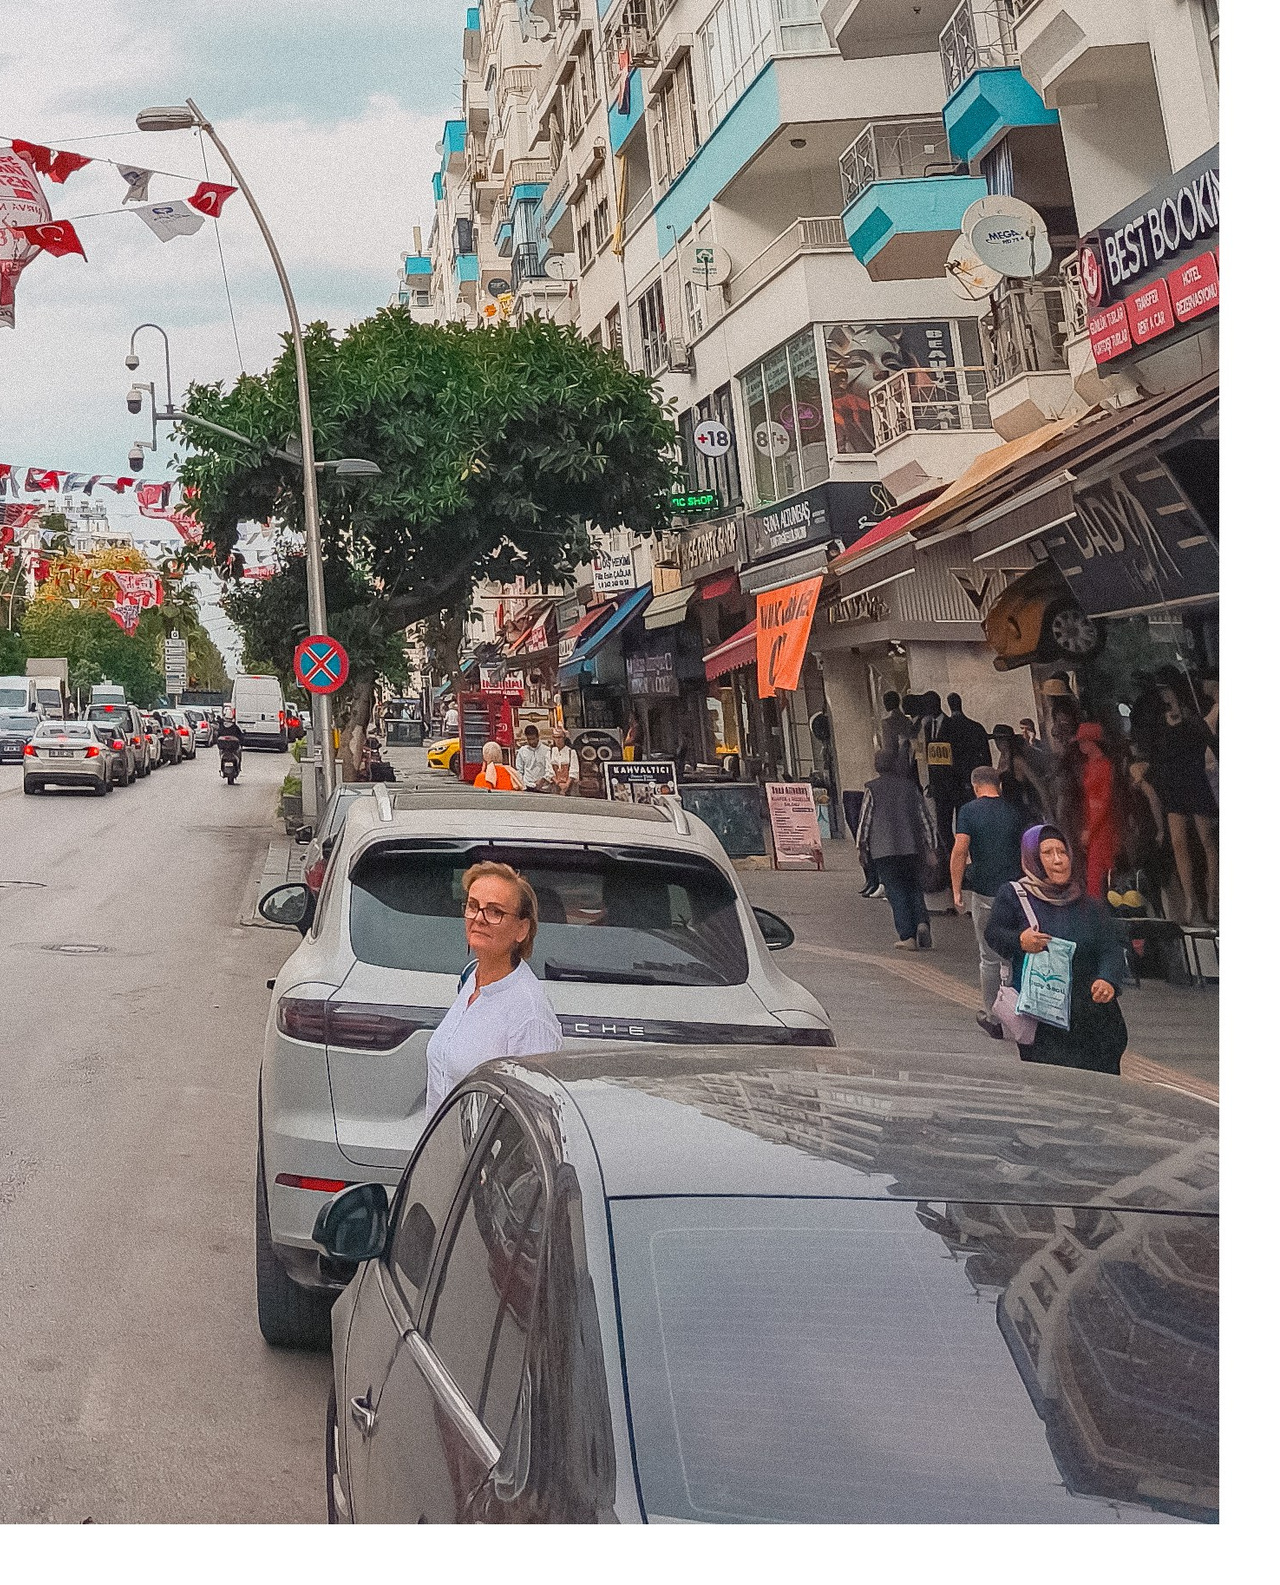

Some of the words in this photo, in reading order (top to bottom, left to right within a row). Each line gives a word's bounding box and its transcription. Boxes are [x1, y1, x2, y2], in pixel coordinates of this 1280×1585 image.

[987, 229, 1019, 241] MEGA
[1105, 215, 1148, 287] BEST
[1182, 266, 1202, 287] HOTEL
[697, 430, 729, 447] +18
[687, 495, 713, 507] SHOP
[613, 766, 670, 774] KAHVALTICI
